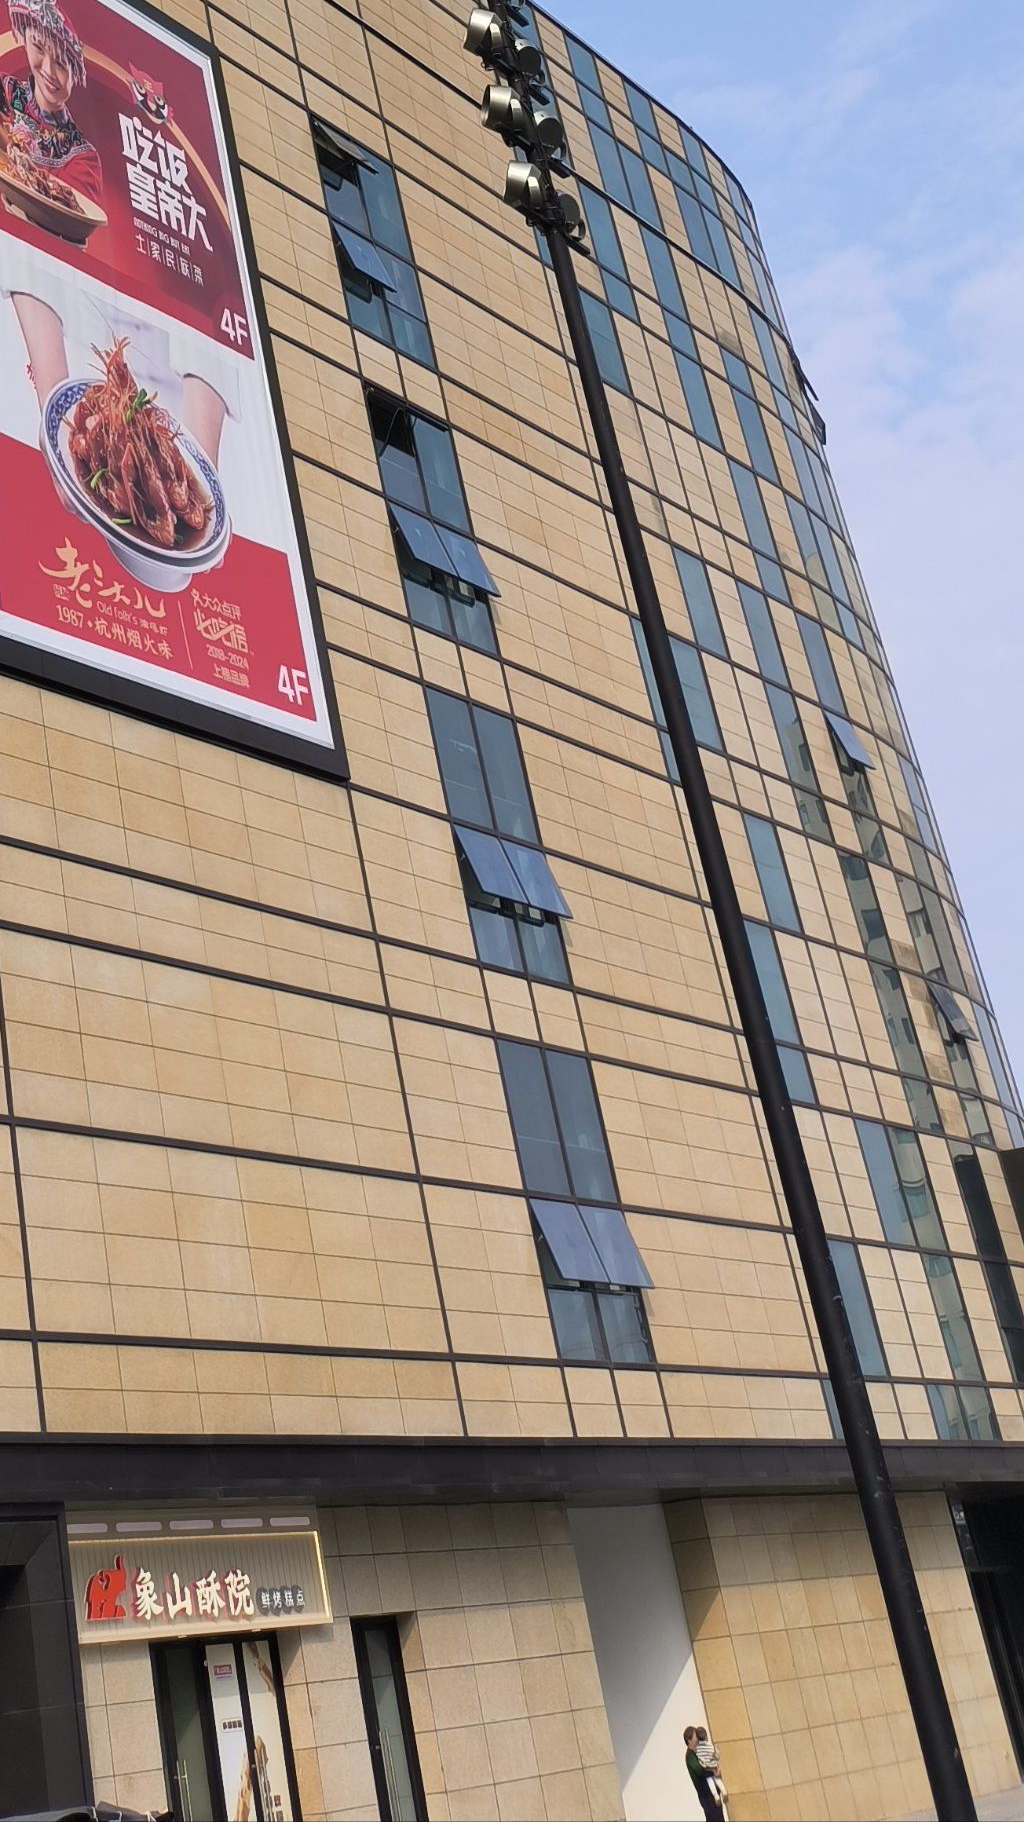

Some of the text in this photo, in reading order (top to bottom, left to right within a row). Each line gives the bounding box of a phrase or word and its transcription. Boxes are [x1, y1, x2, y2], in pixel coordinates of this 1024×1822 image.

[118, 112, 192, 195] 吃饭
[126, 162, 214, 253] 皇帝大
[219, 308, 249, 346] 4F
[96, 601, 113, 616] Old
[203, 593, 241, 621] 大众点评
[277, 664, 309, 706] 4F
[135, 1567, 255, 1620] 象山酥院
